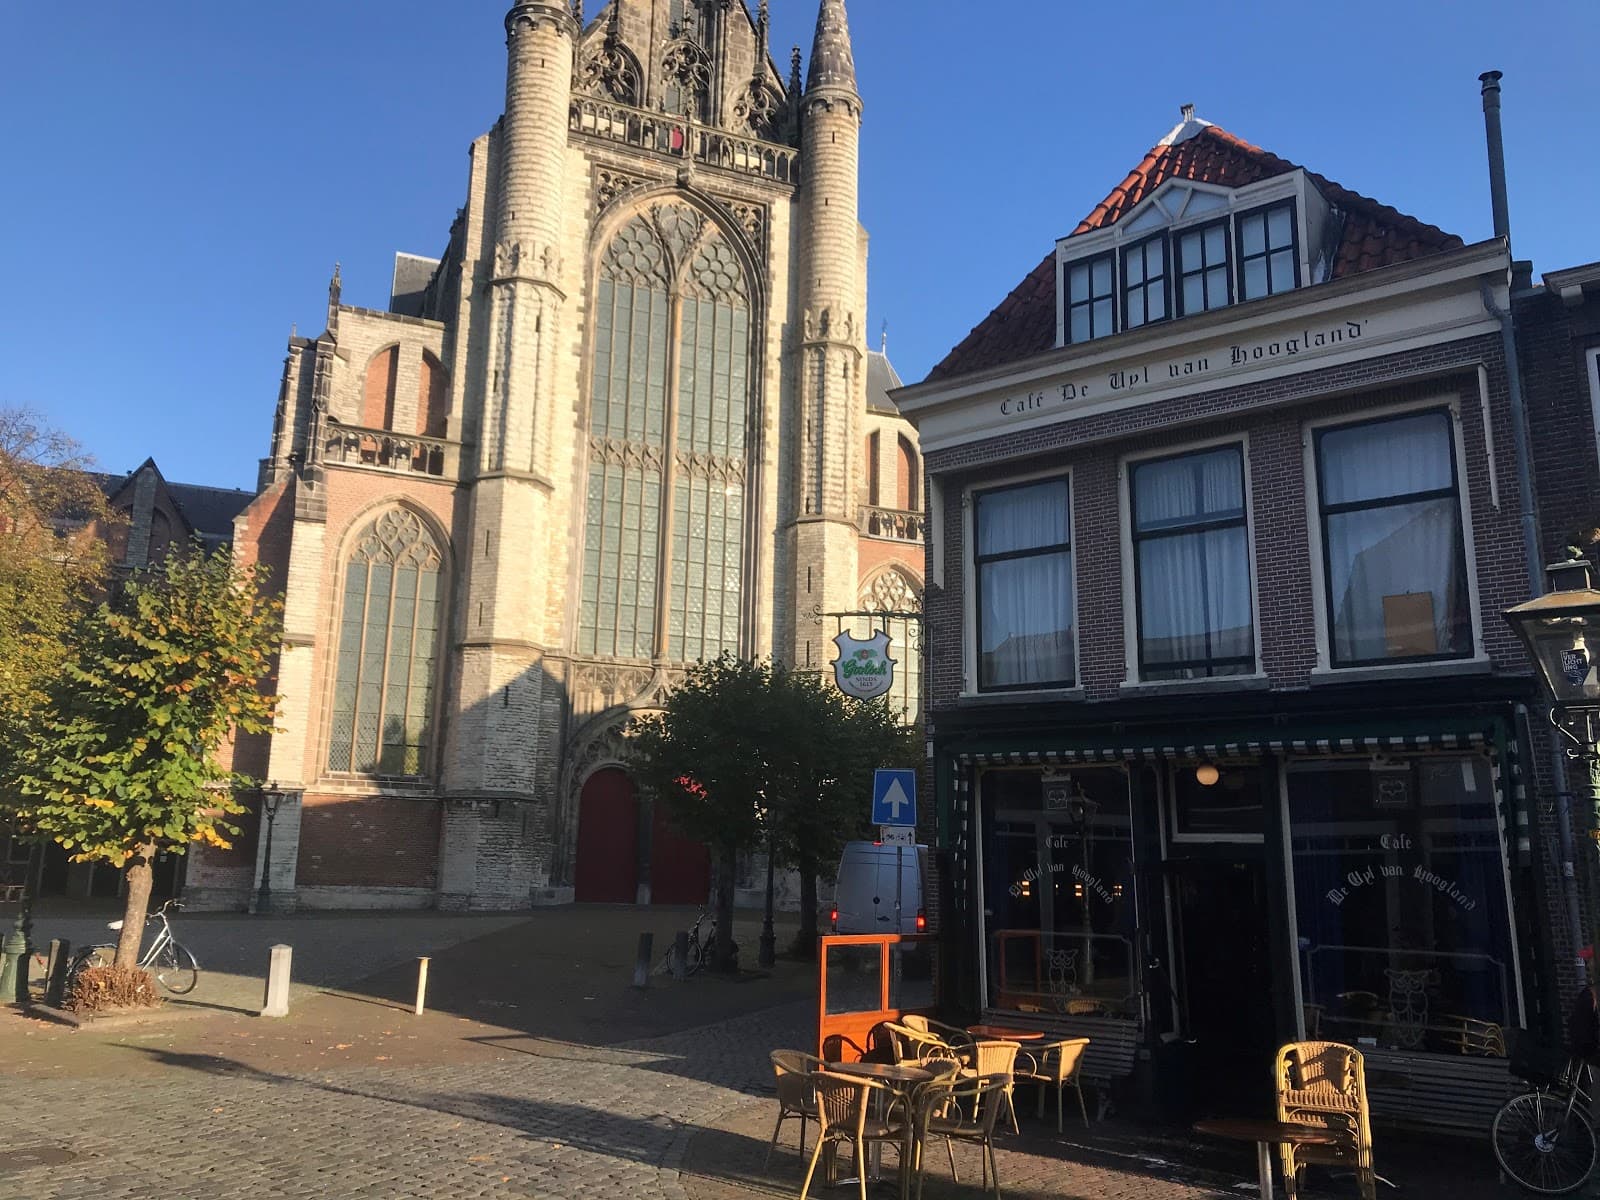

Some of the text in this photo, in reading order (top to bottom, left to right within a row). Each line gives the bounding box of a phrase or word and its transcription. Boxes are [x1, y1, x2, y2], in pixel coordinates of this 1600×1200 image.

[1109, 366, 1149, 390] Uyl
[1326, 864, 1476, 911] De Uyl van Hoogland
